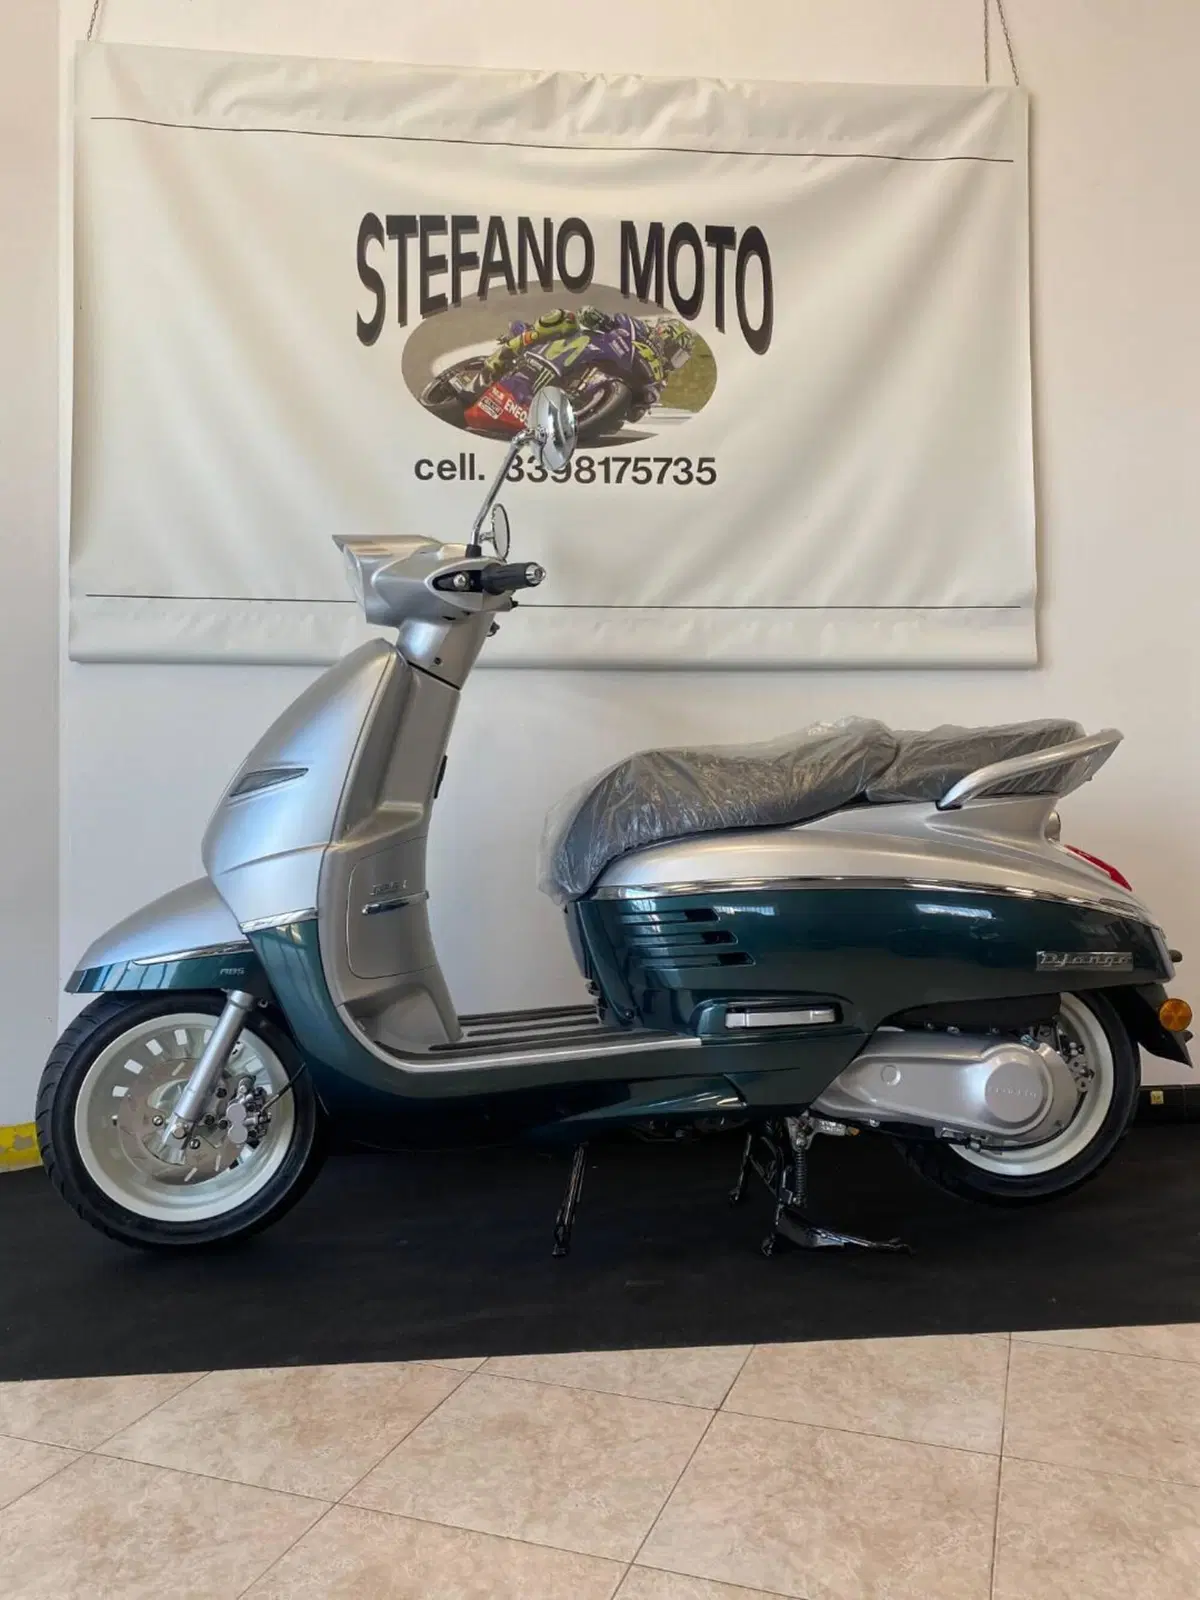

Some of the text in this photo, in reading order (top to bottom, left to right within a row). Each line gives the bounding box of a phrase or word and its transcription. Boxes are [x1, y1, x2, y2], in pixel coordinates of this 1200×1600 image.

[356, 211, 775, 356] STEFANO MOTO
[503, 398, 529, 429] ENEO
[413, 452, 486, 481] cell.
